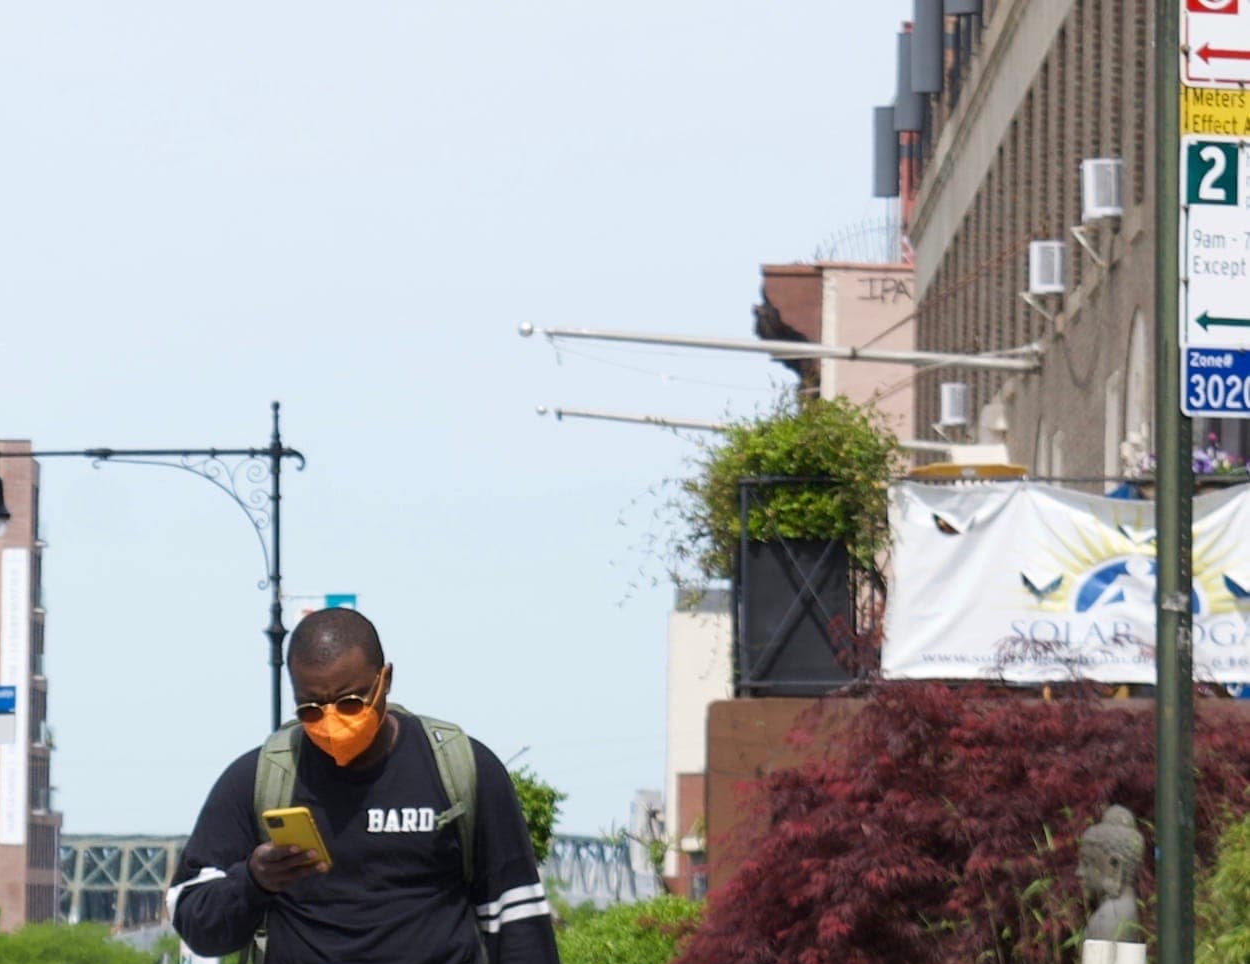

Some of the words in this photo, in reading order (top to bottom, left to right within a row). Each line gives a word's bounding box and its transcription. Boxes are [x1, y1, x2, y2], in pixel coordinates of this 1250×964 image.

[1192, 87, 1246, 109] Meters
[1192, 114, 1238, 135] Effect
[1198, 145, 1227, 200] 2
[1192, 228, 1227, 249] 9am
[1192, 255, 1247, 278] Except
[1010, 619, 1135, 646] SOLAR
[366, 808, 434, 832] BARD
